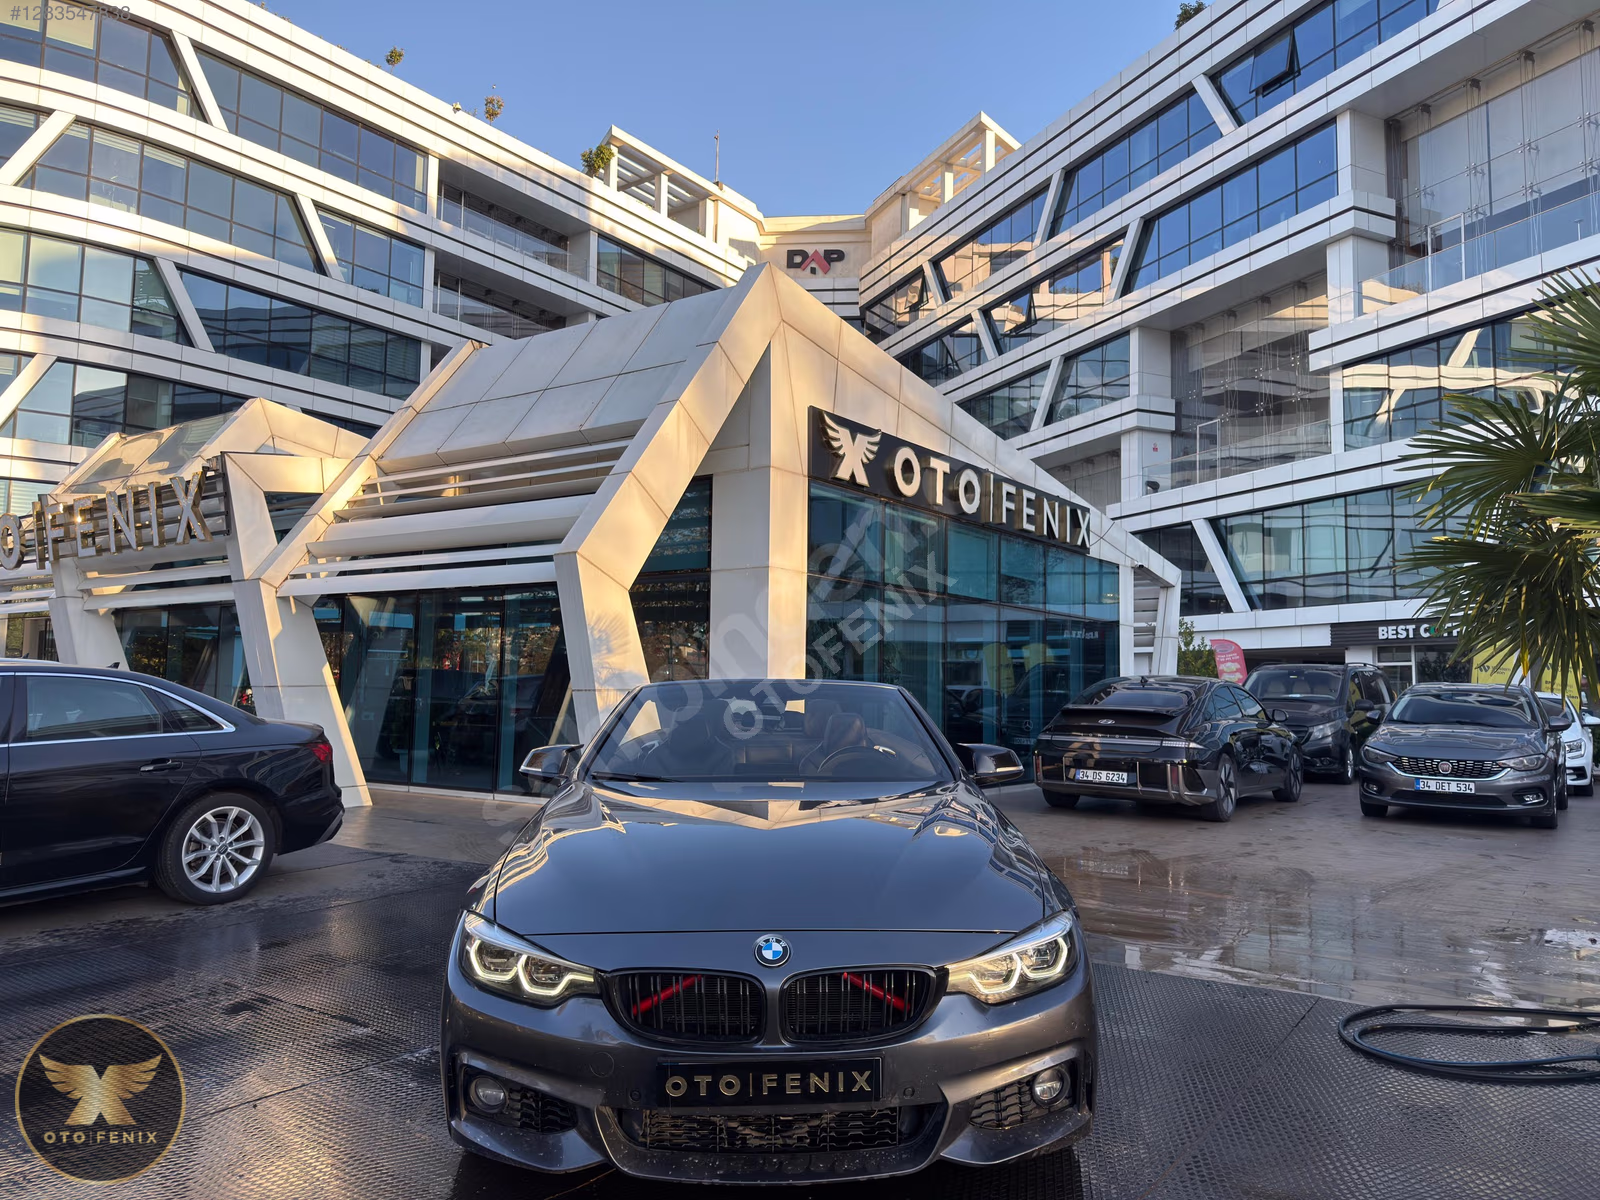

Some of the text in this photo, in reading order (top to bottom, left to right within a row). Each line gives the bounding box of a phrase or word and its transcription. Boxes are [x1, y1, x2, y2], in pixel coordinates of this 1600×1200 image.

[1378, 624, 1416, 640] BEST
[1080, 770, 1089, 780] 34
[1105, 773, 1125, 783] 6234
[1420, 780, 1431, 790] 34
[1435, 781, 1452, 791] DET
[1456, 782, 1473, 793] 534
